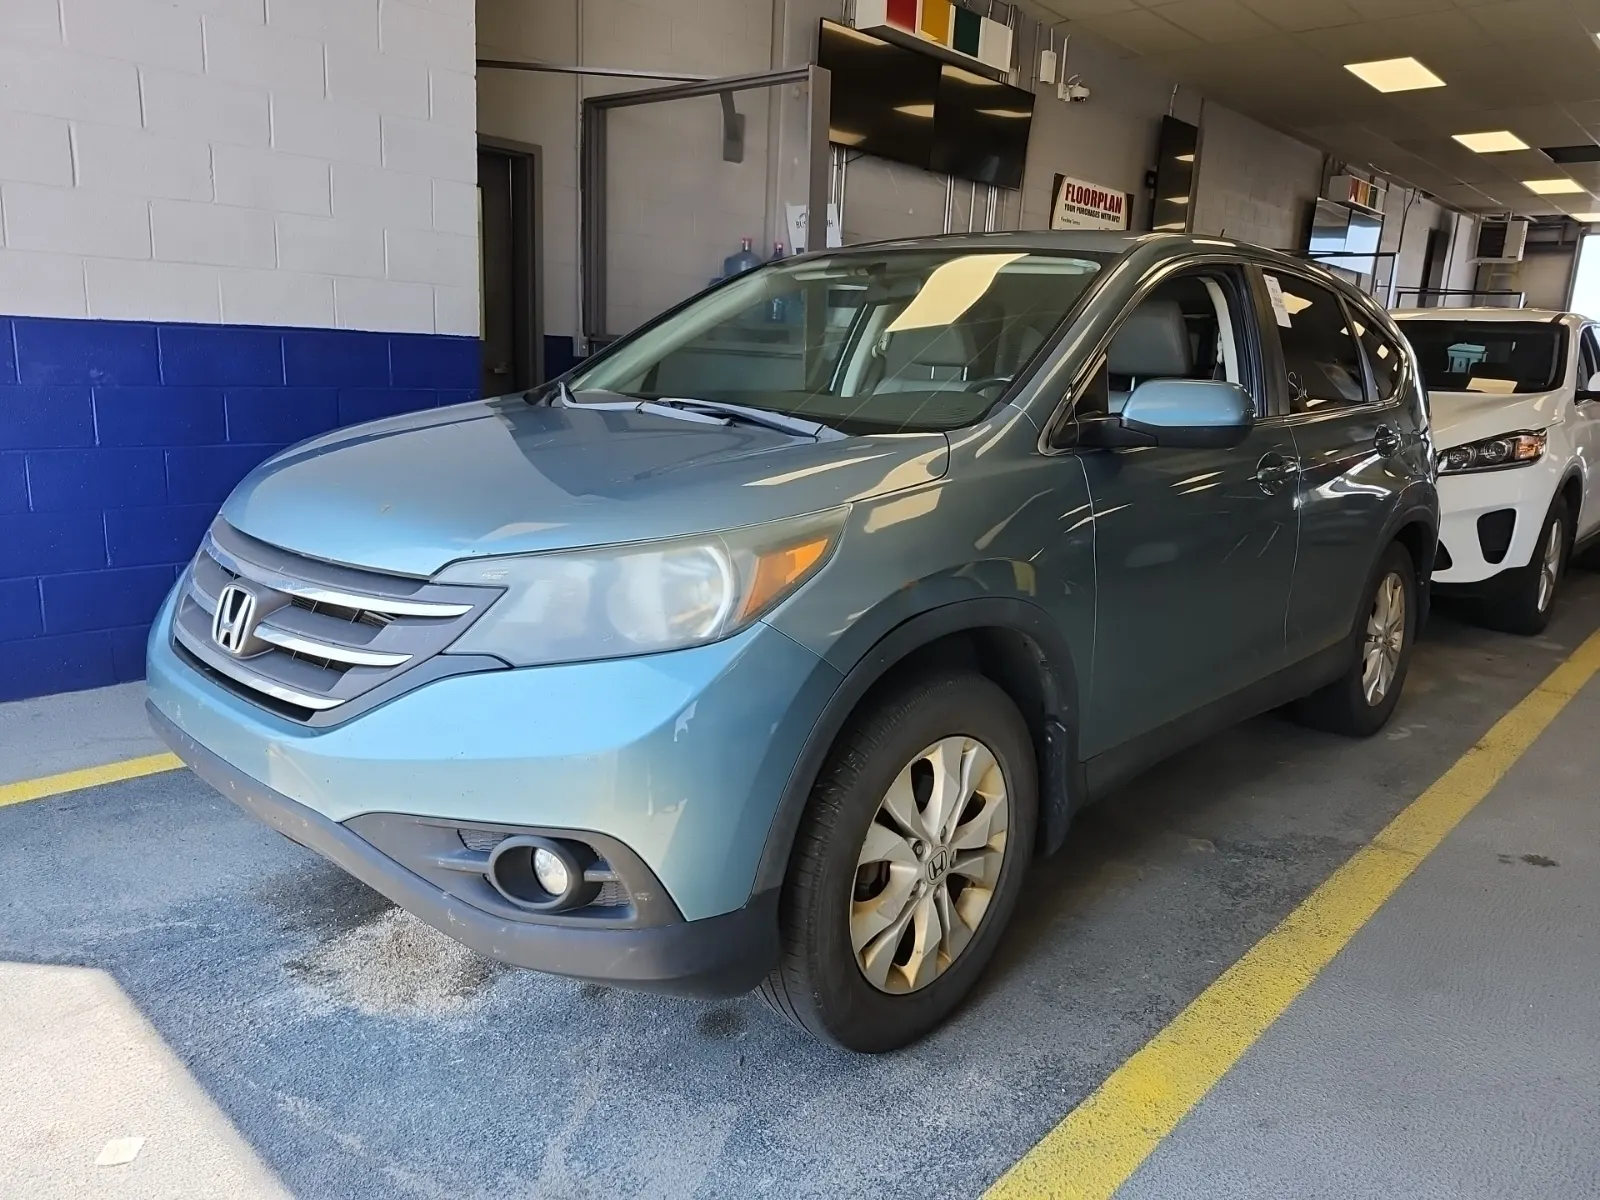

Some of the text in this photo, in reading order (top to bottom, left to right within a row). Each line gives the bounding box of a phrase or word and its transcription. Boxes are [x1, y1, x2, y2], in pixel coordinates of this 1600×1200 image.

[1065, 183, 1122, 214] FLOORPLAN
[1064, 203, 1076, 213] YOUR
[1076, 207, 1101, 218] PURCHASES
[1100, 212, 1112, 221] WITH
